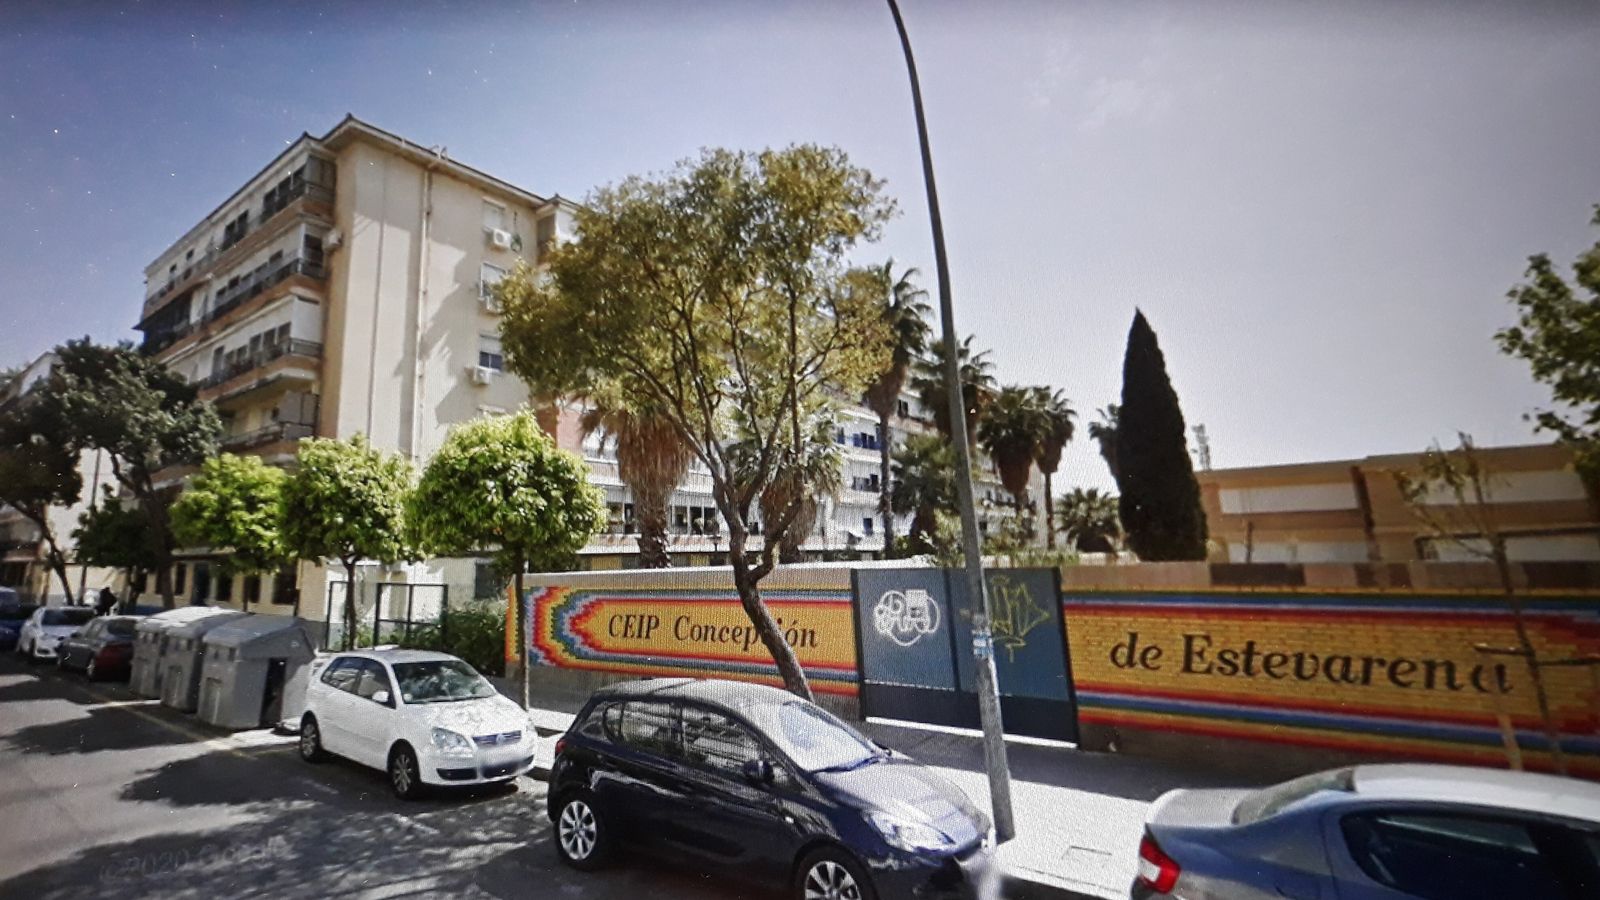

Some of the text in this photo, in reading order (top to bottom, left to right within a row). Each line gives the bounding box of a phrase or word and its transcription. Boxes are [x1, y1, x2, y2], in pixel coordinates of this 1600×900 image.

[608, 613, 817, 652] CEIP Concepón
[1109, 631, 1514, 694] de Estevarena
